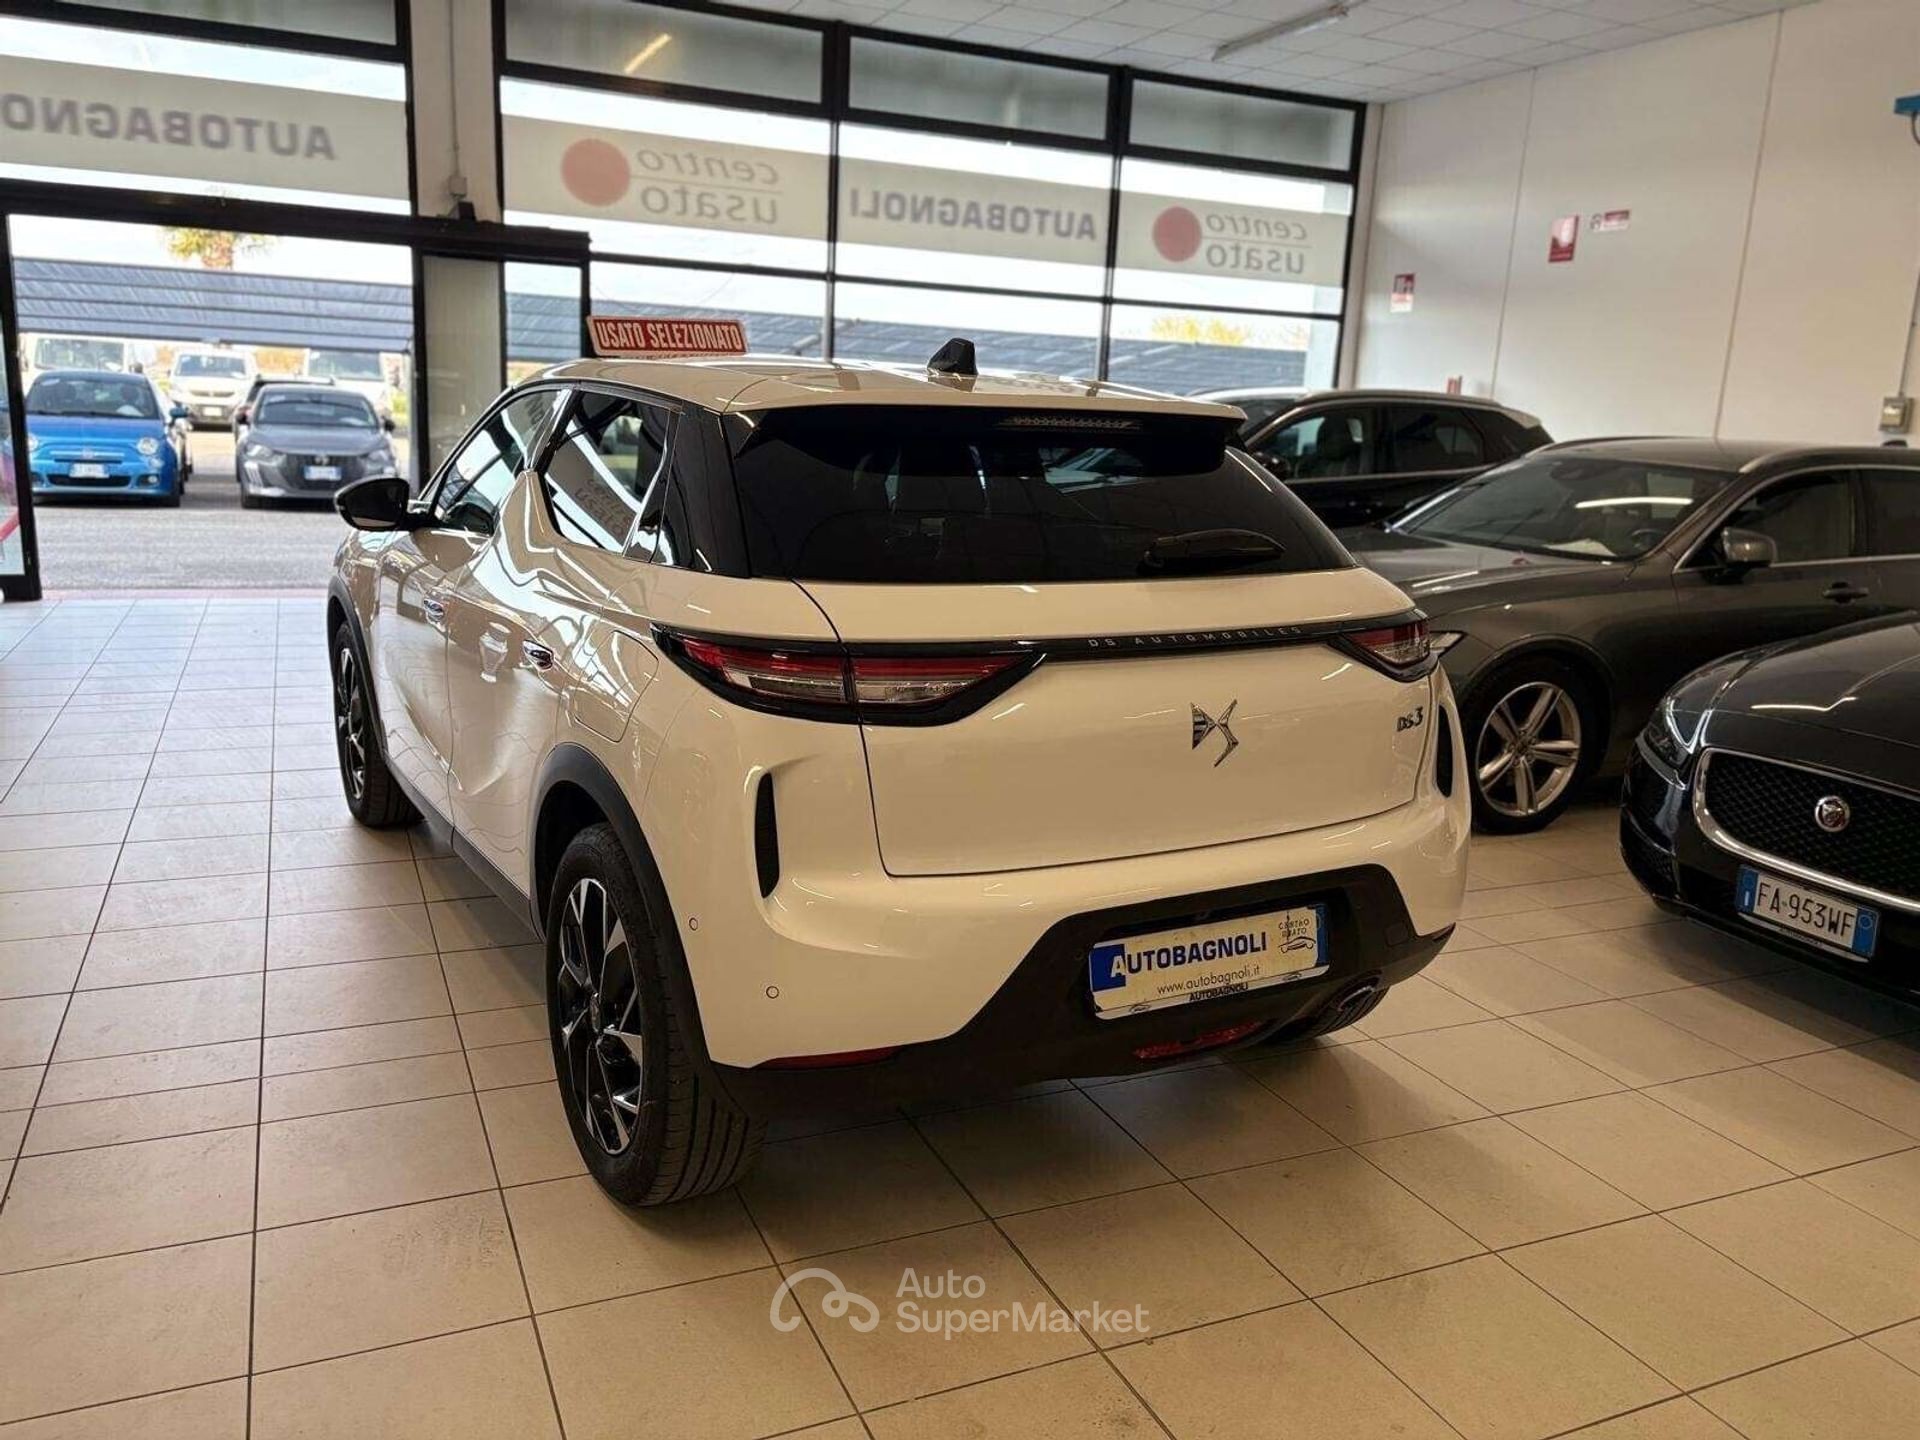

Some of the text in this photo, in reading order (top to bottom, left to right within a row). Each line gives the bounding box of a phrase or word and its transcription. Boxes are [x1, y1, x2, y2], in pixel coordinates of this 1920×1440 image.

[596, 321, 743, 350] USATO SELEZIONATO
[1088, 626, 1302, 648] DS AUTOMOBILES
[1110, 931, 1267, 978] AUTOBAGNOLI
[1157, 964, 1261, 995] www.autobagnoli.it
[1189, 982, 1250, 1002] AUTOBAGNOLI
